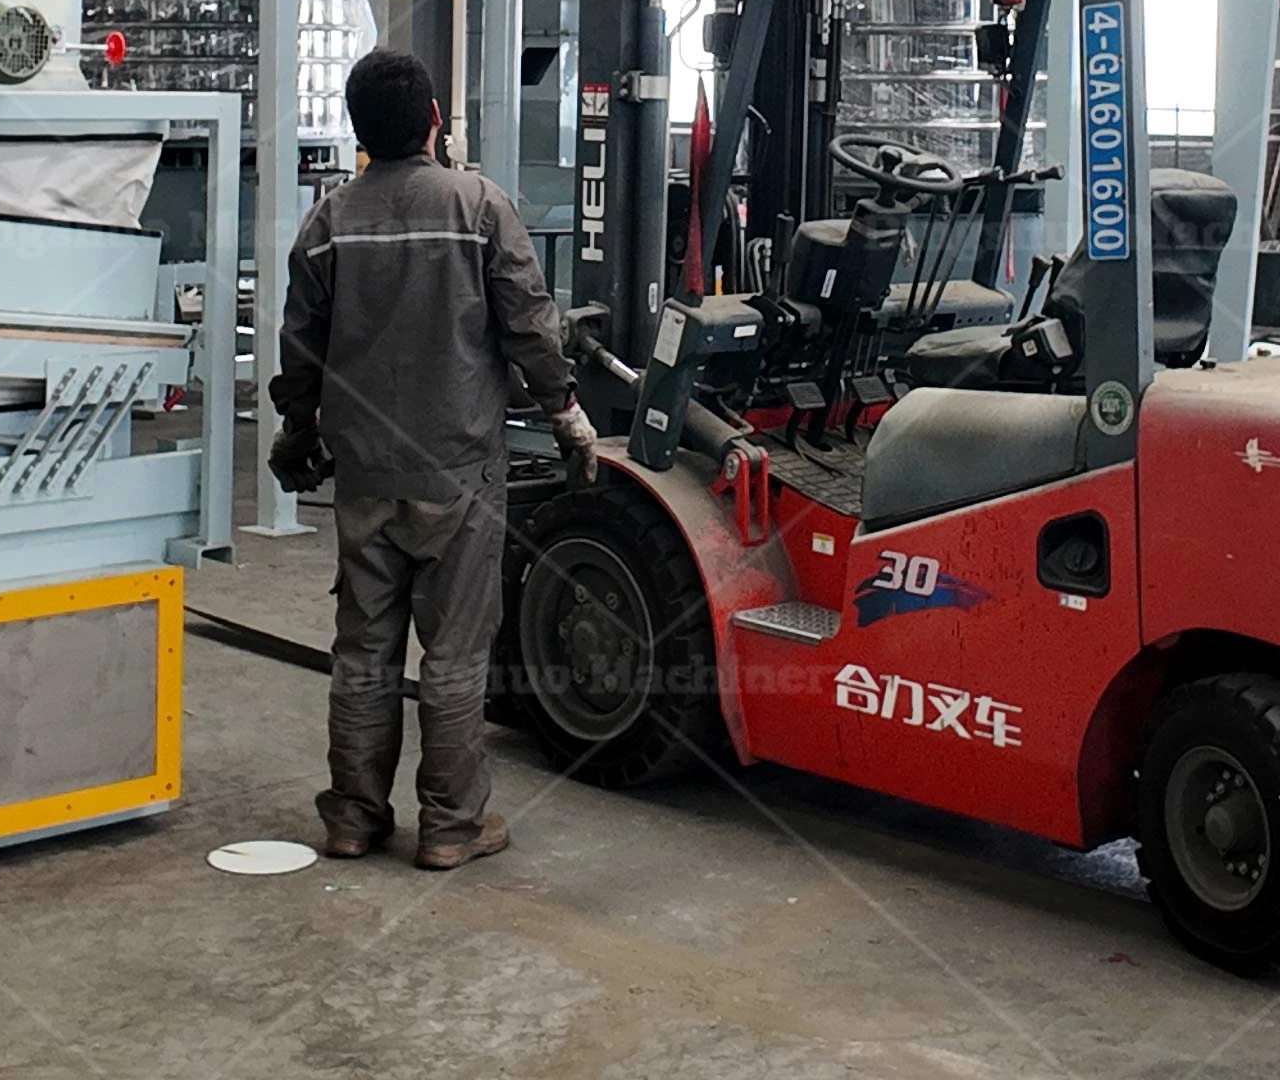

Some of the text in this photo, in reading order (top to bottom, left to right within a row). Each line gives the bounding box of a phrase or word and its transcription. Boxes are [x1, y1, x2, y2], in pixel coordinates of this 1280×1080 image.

[1087, 9, 1125, 252] 4-GA601600
[581, 127, 607, 262] HELI
[872, 549, 940, 597] 30
[833, 663, 1023, 748] 合力叉车
